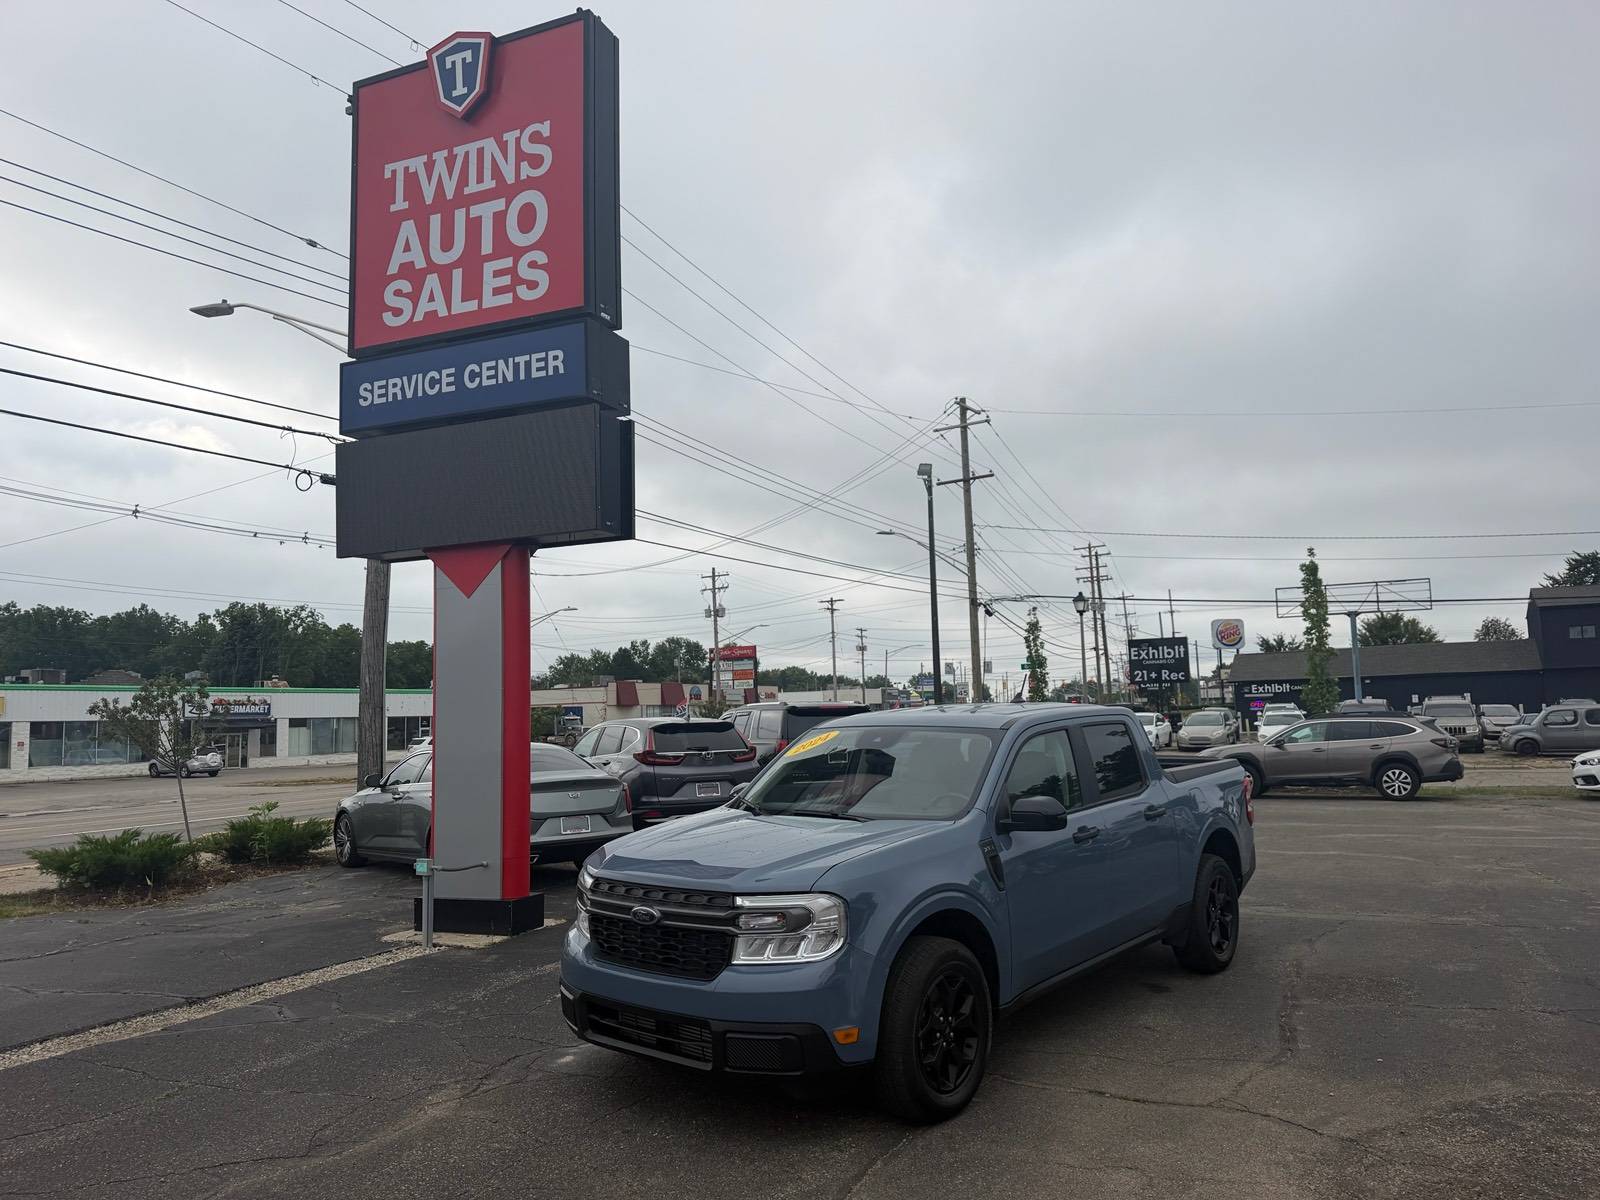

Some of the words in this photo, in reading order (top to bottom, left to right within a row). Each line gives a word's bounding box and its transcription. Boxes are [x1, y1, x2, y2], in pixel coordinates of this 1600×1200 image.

[445, 48, 472, 97] T
[384, 120, 552, 213] TWINS
[386, 190, 549, 276] AUTO
[382, 250, 550, 328] SALES
[358, 366, 456, 407] SERVICE
[463, 348, 564, 390] CENTER
[1130, 645, 1185, 660] Exhibit
[1220, 629, 1241, 641] KING
[1134, 670, 1158, 681] 21+
[1161, 669, 1185, 681] Rec
[1251, 683, 1291, 693] Exhibit
